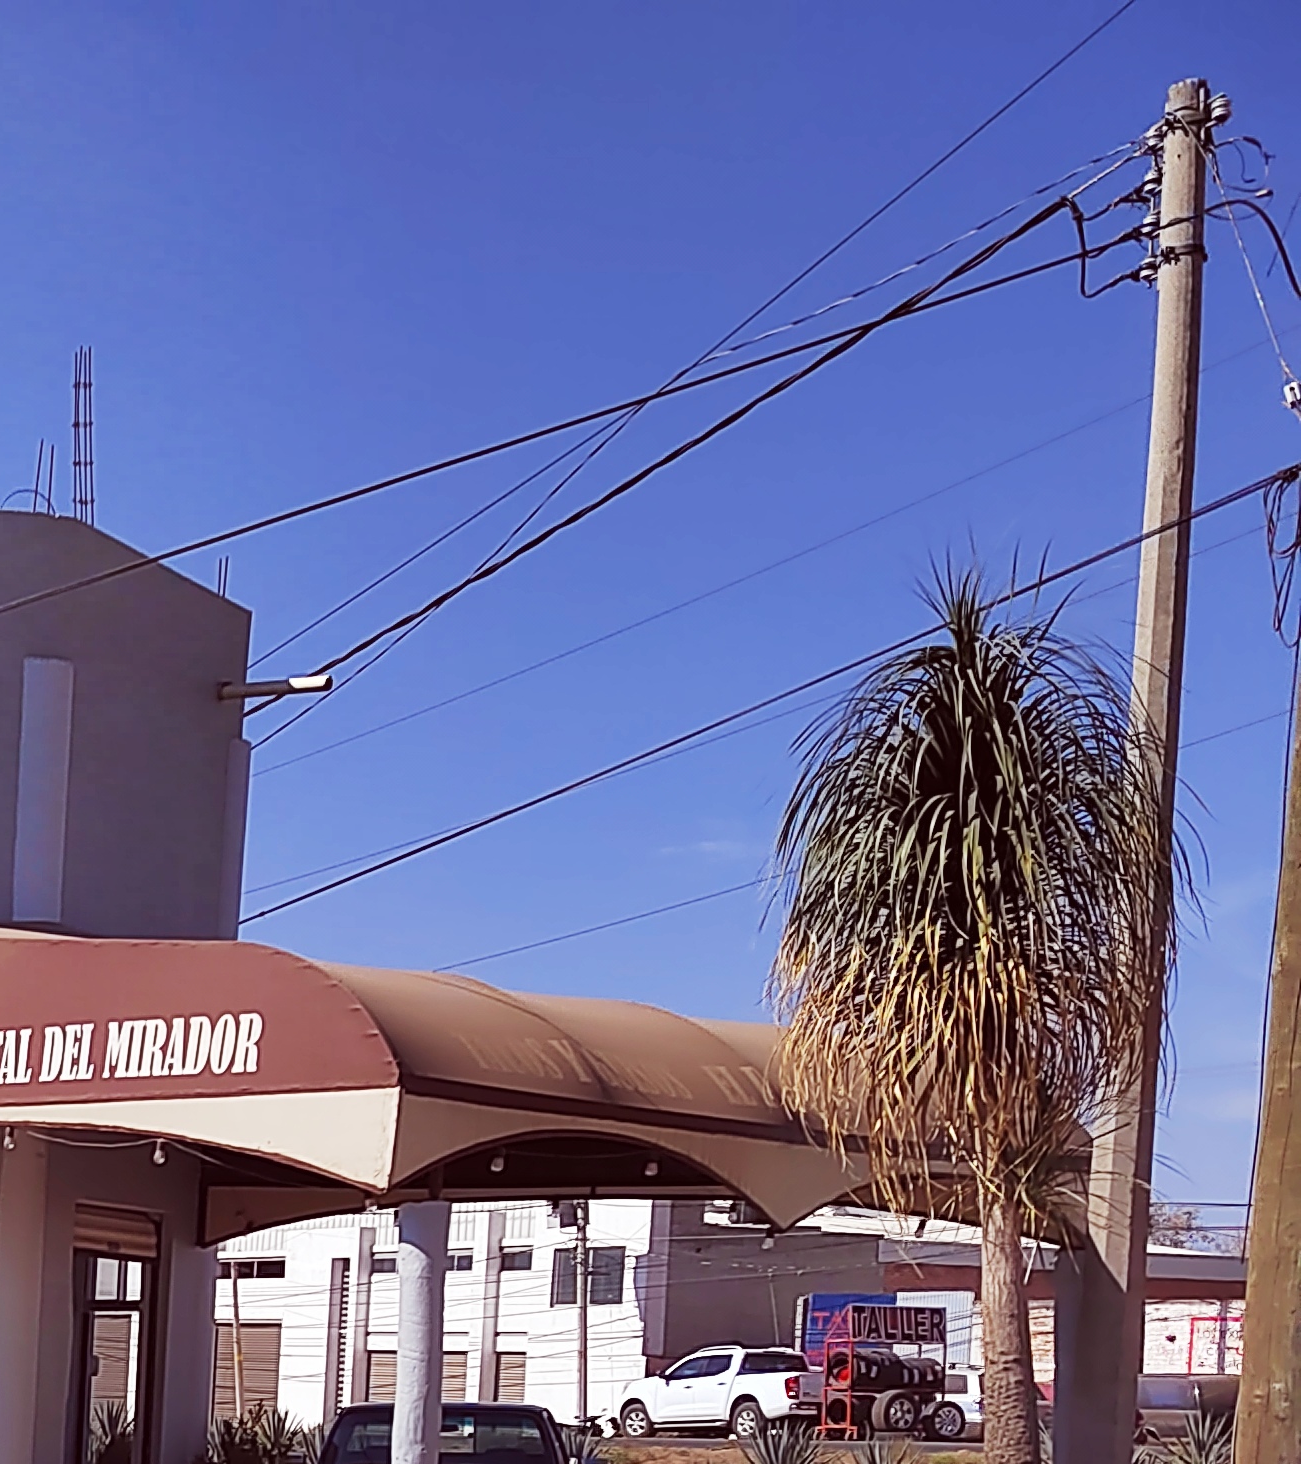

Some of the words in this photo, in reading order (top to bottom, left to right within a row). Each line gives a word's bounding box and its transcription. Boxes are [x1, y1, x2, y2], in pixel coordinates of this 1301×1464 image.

[39, 1023, 95, 1083] DEL
[102, 1012, 263, 1079] MIRADOR
[852, 1306, 945, 1341] TALLER
